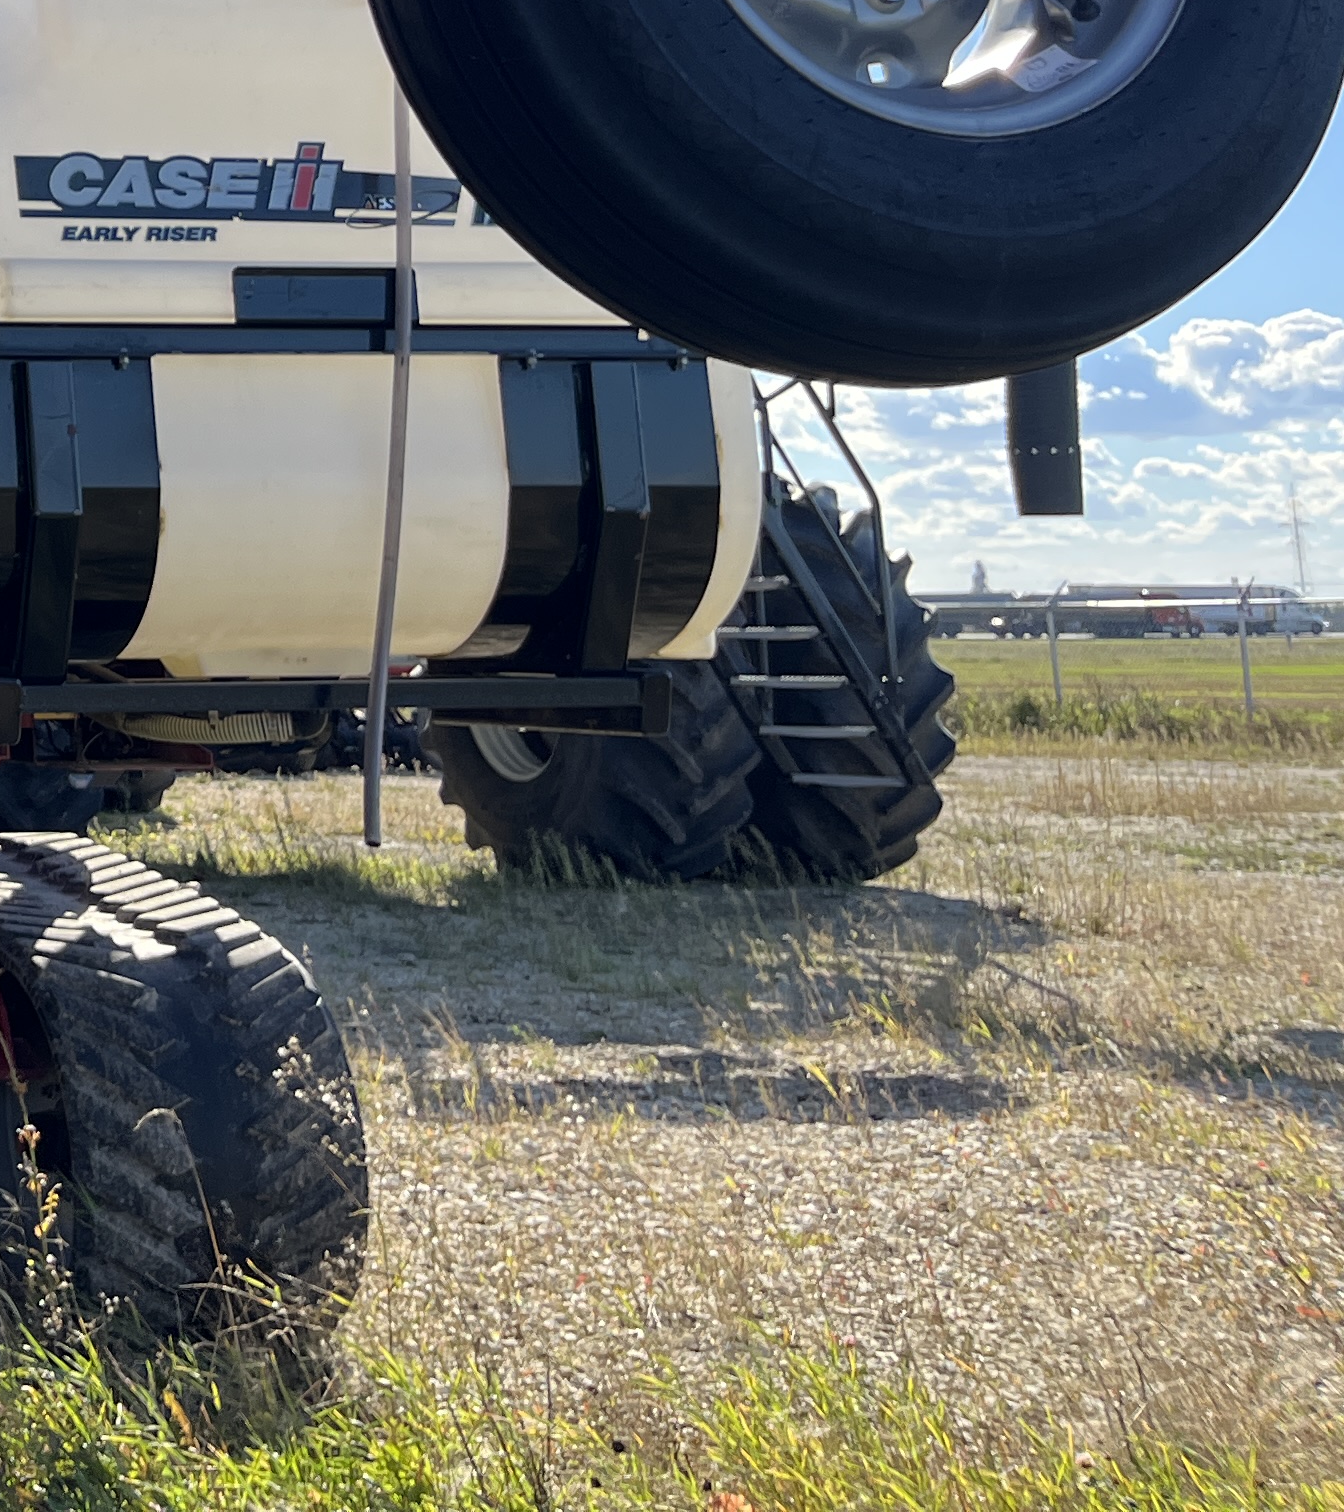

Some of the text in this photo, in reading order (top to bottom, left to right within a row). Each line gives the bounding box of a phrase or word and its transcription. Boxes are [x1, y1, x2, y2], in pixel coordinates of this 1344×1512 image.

[49, 144, 340, 212] CASE IH
[61, 225, 218, 242] EARLY RISER
